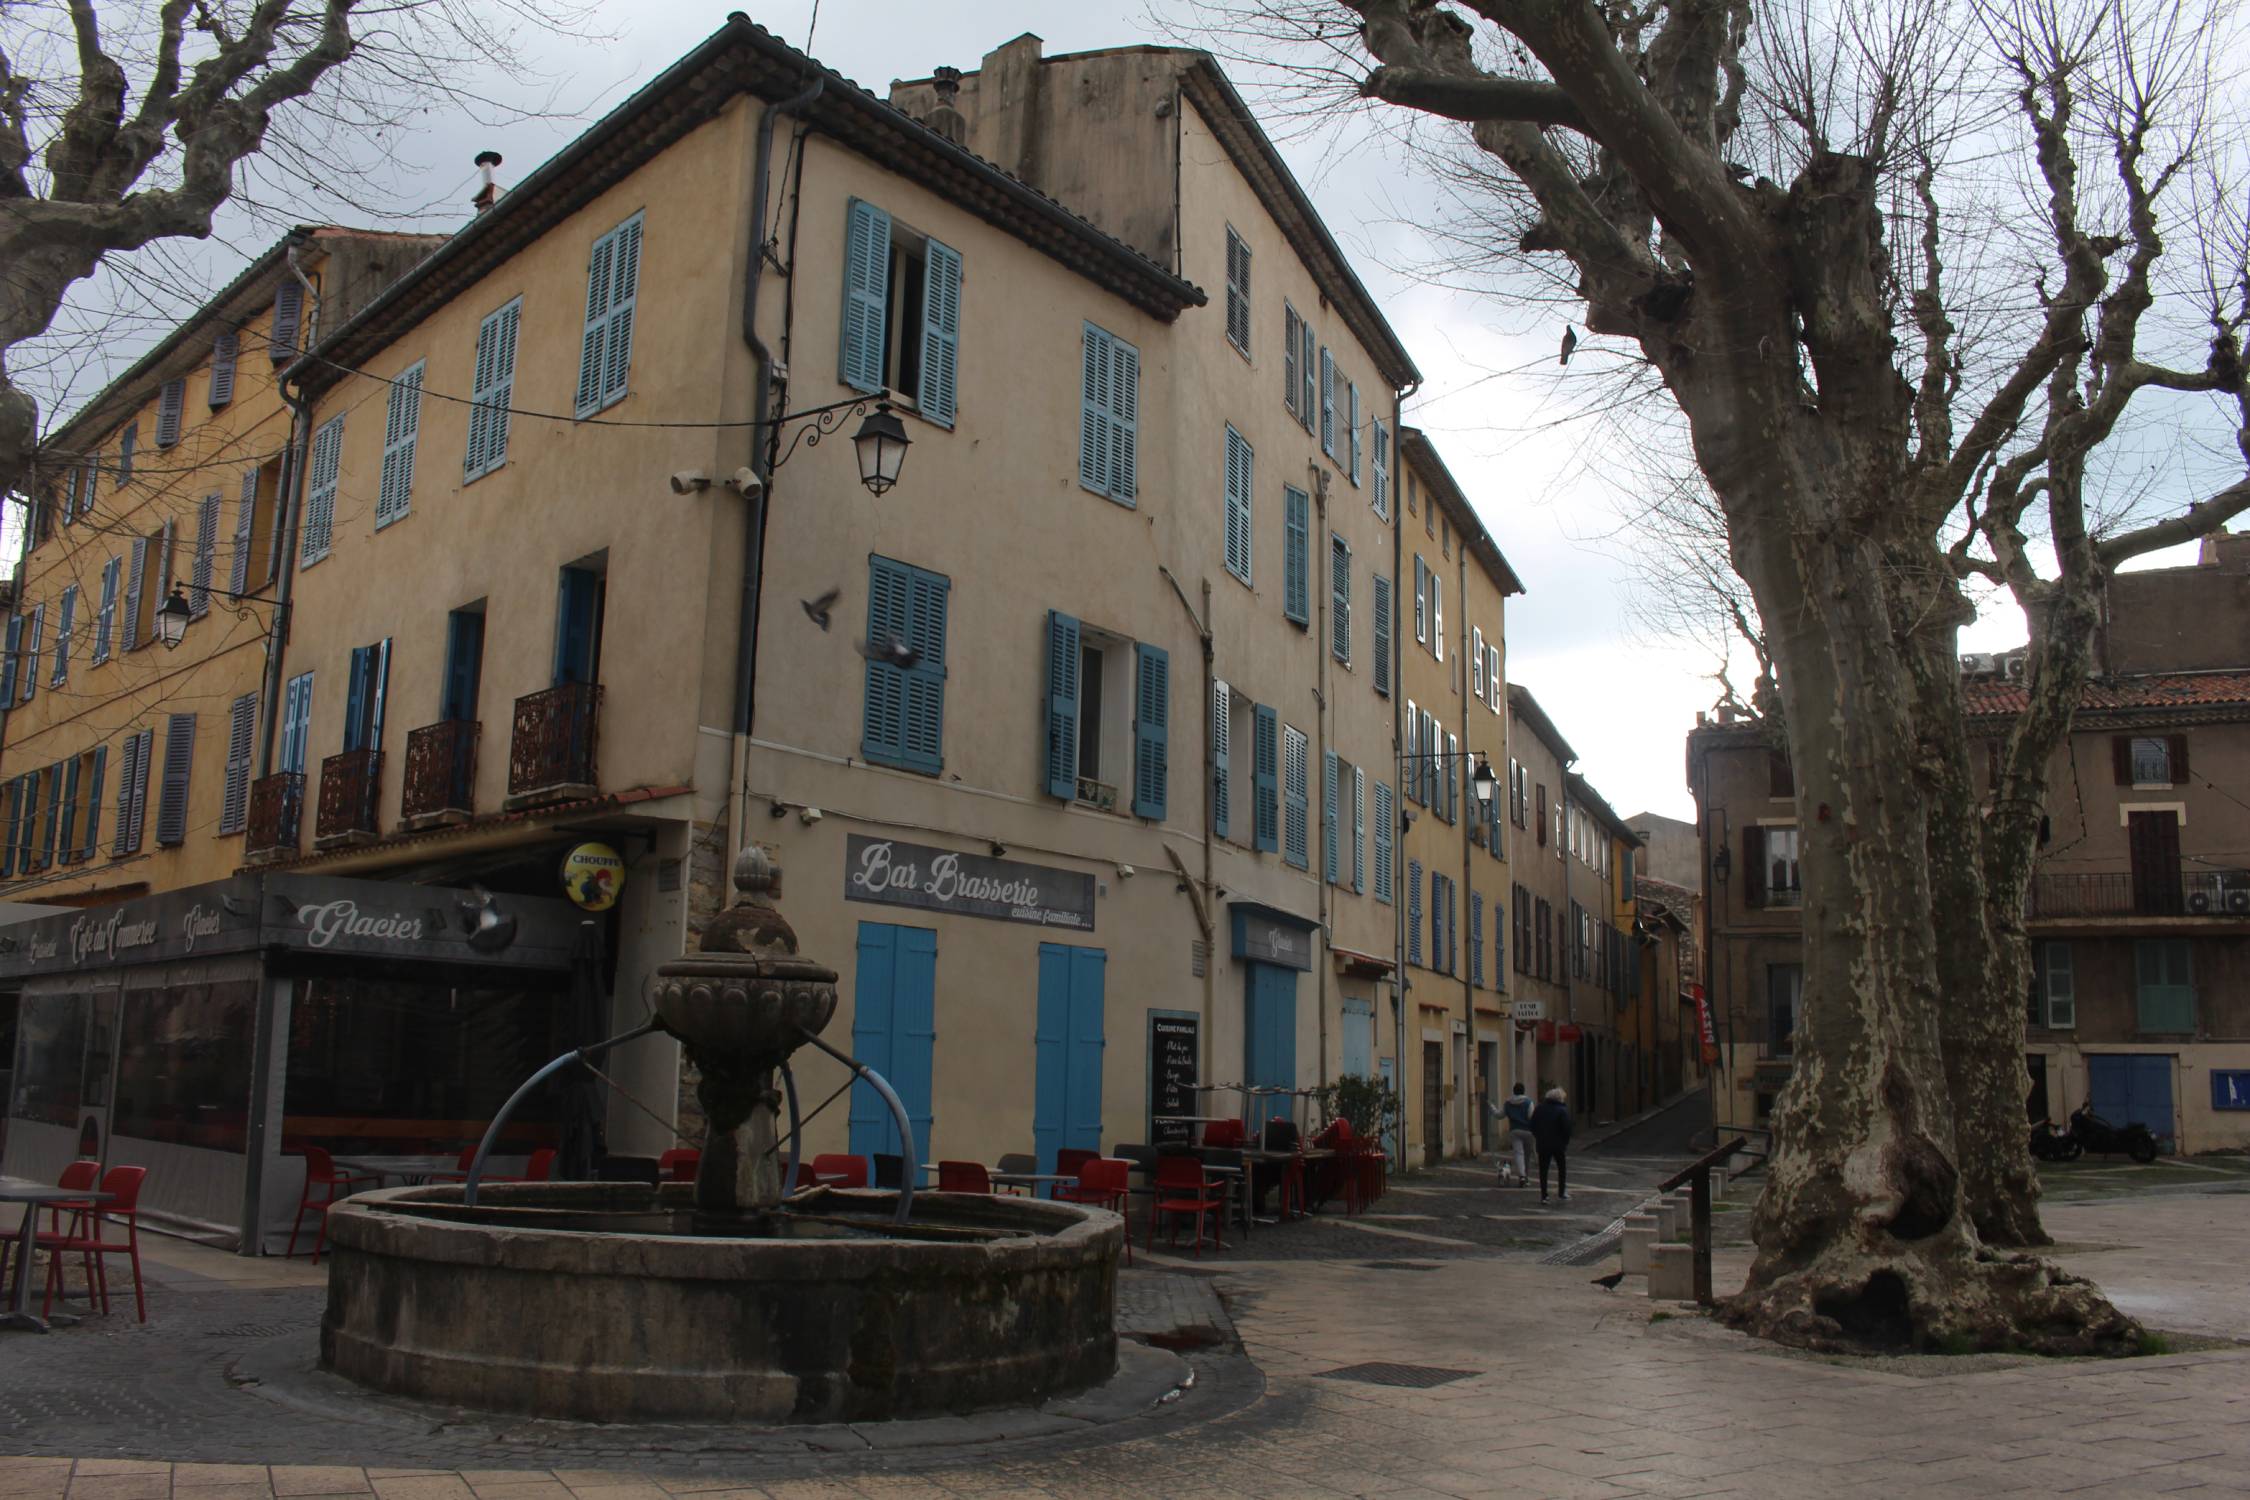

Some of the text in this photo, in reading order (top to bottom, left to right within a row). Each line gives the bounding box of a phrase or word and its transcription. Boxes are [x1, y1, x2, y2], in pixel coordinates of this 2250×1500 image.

[853, 842, 1038, 906] Bar Brasserie
[70, 908, 157, 964] Café du Commerce
[184, 904, 220, 952] Glacier
[298, 900, 422, 947] Glacier
[1012, 906, 1042, 920] cuisine
[1699, 998, 1715, 1043] PIZZA
